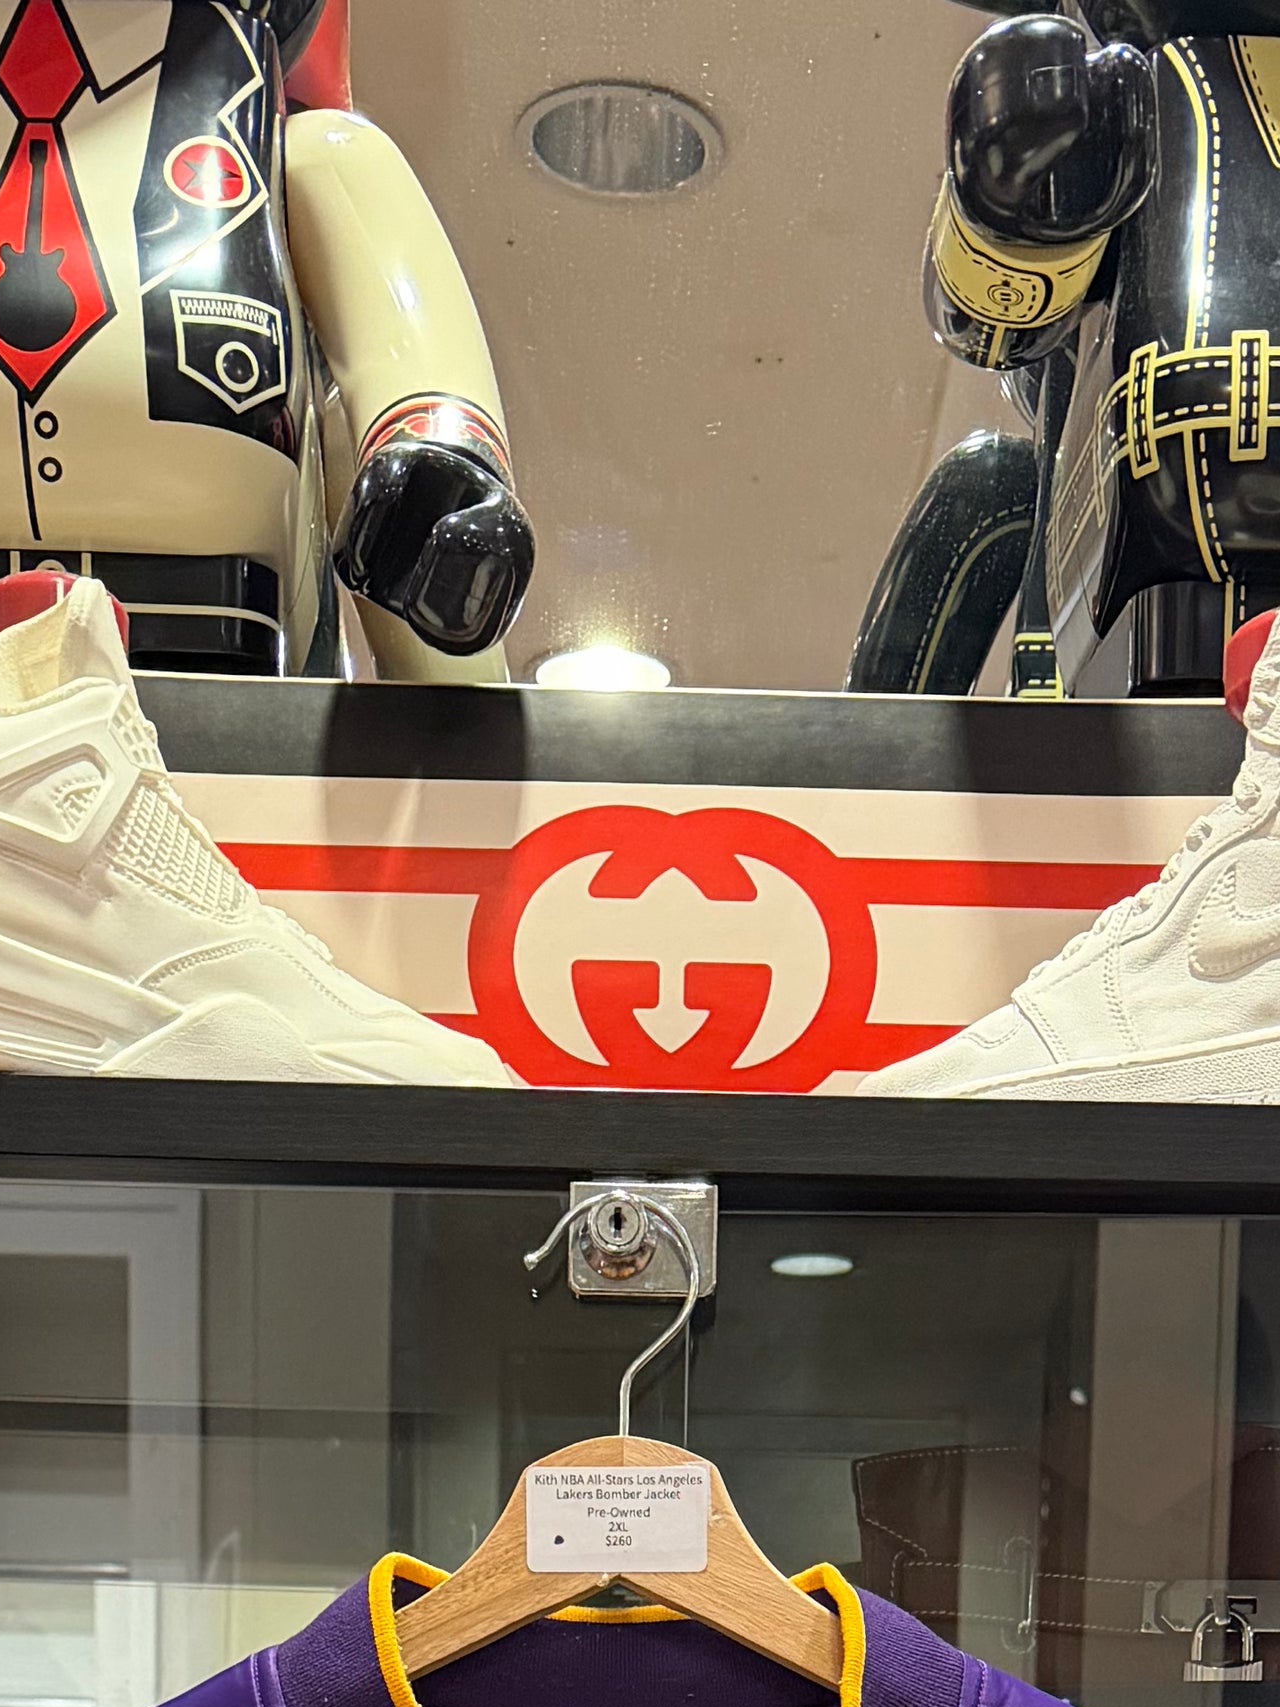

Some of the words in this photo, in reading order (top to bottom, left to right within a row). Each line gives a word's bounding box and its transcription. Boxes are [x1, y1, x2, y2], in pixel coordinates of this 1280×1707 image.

[534, 1474, 558, 1486] Kith
[560, 1474, 585, 1486] NBA
[586, 1474, 634, 1486] All-Stars
[636, 1474, 656, 1486] Los
[658, 1474, 703, 1488] Angeles
[556, 1489, 594, 1500] Lakers
[595, 1489, 642, 1500] Bomber
[643, 1489, 681, 1500] Jacket
[587, 1506, 651, 1518] Pre-Owned
[608, 1521, 629, 1533] 2XL
[605, 1535, 632, 1547] $260
